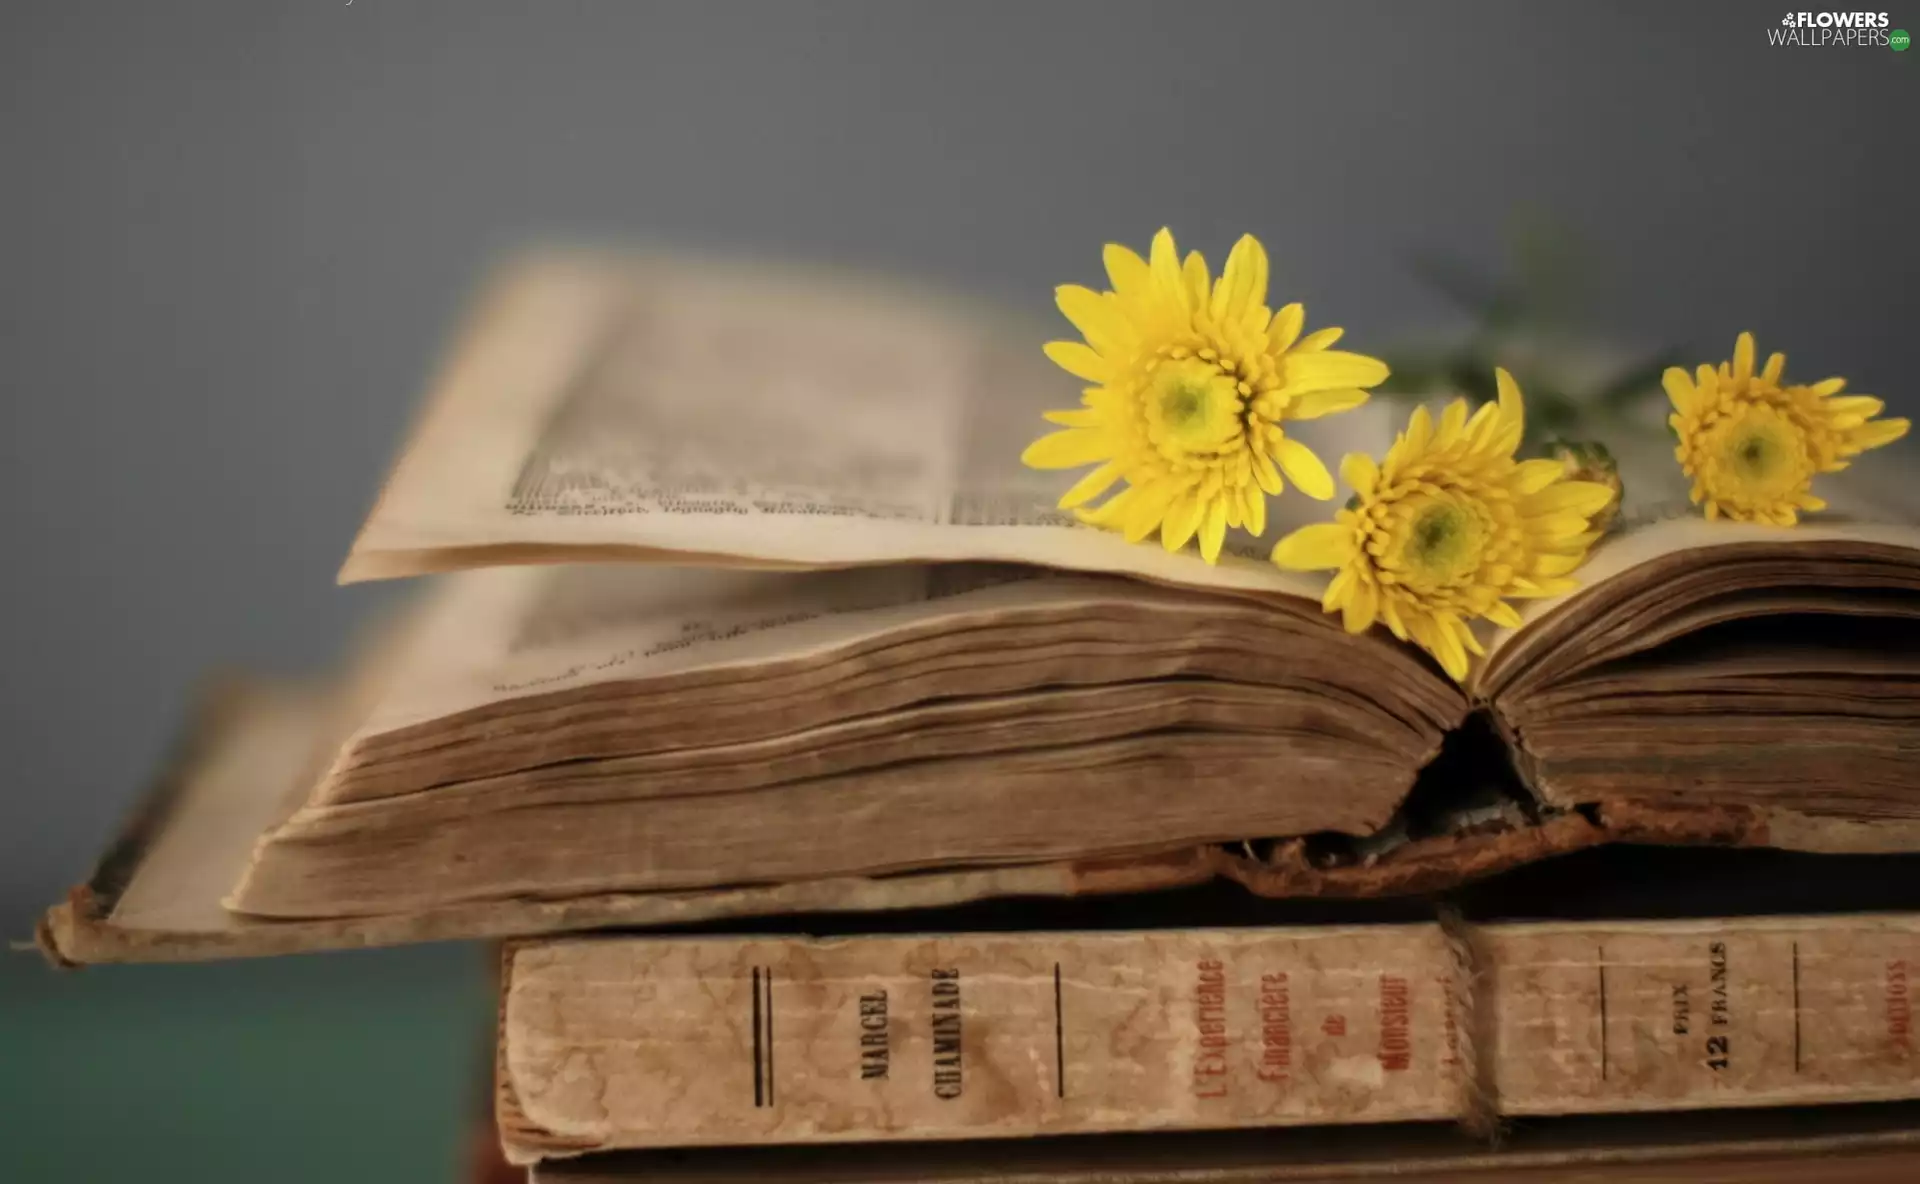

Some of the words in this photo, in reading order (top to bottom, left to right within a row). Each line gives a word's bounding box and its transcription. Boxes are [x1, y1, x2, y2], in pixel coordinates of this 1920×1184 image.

[1321, 1014, 1346, 1037] de
[1377, 973, 1411, 1071] Monsieur
[1672, 984, 1689, 1035] PRIX
[1709, 942, 1728, 1026] FRANCS
[859, 990, 889, 1080] MARCEL
[931, 968, 962, 1099] CHAMINADE
[1706, 1035, 1729, 1071] 12
